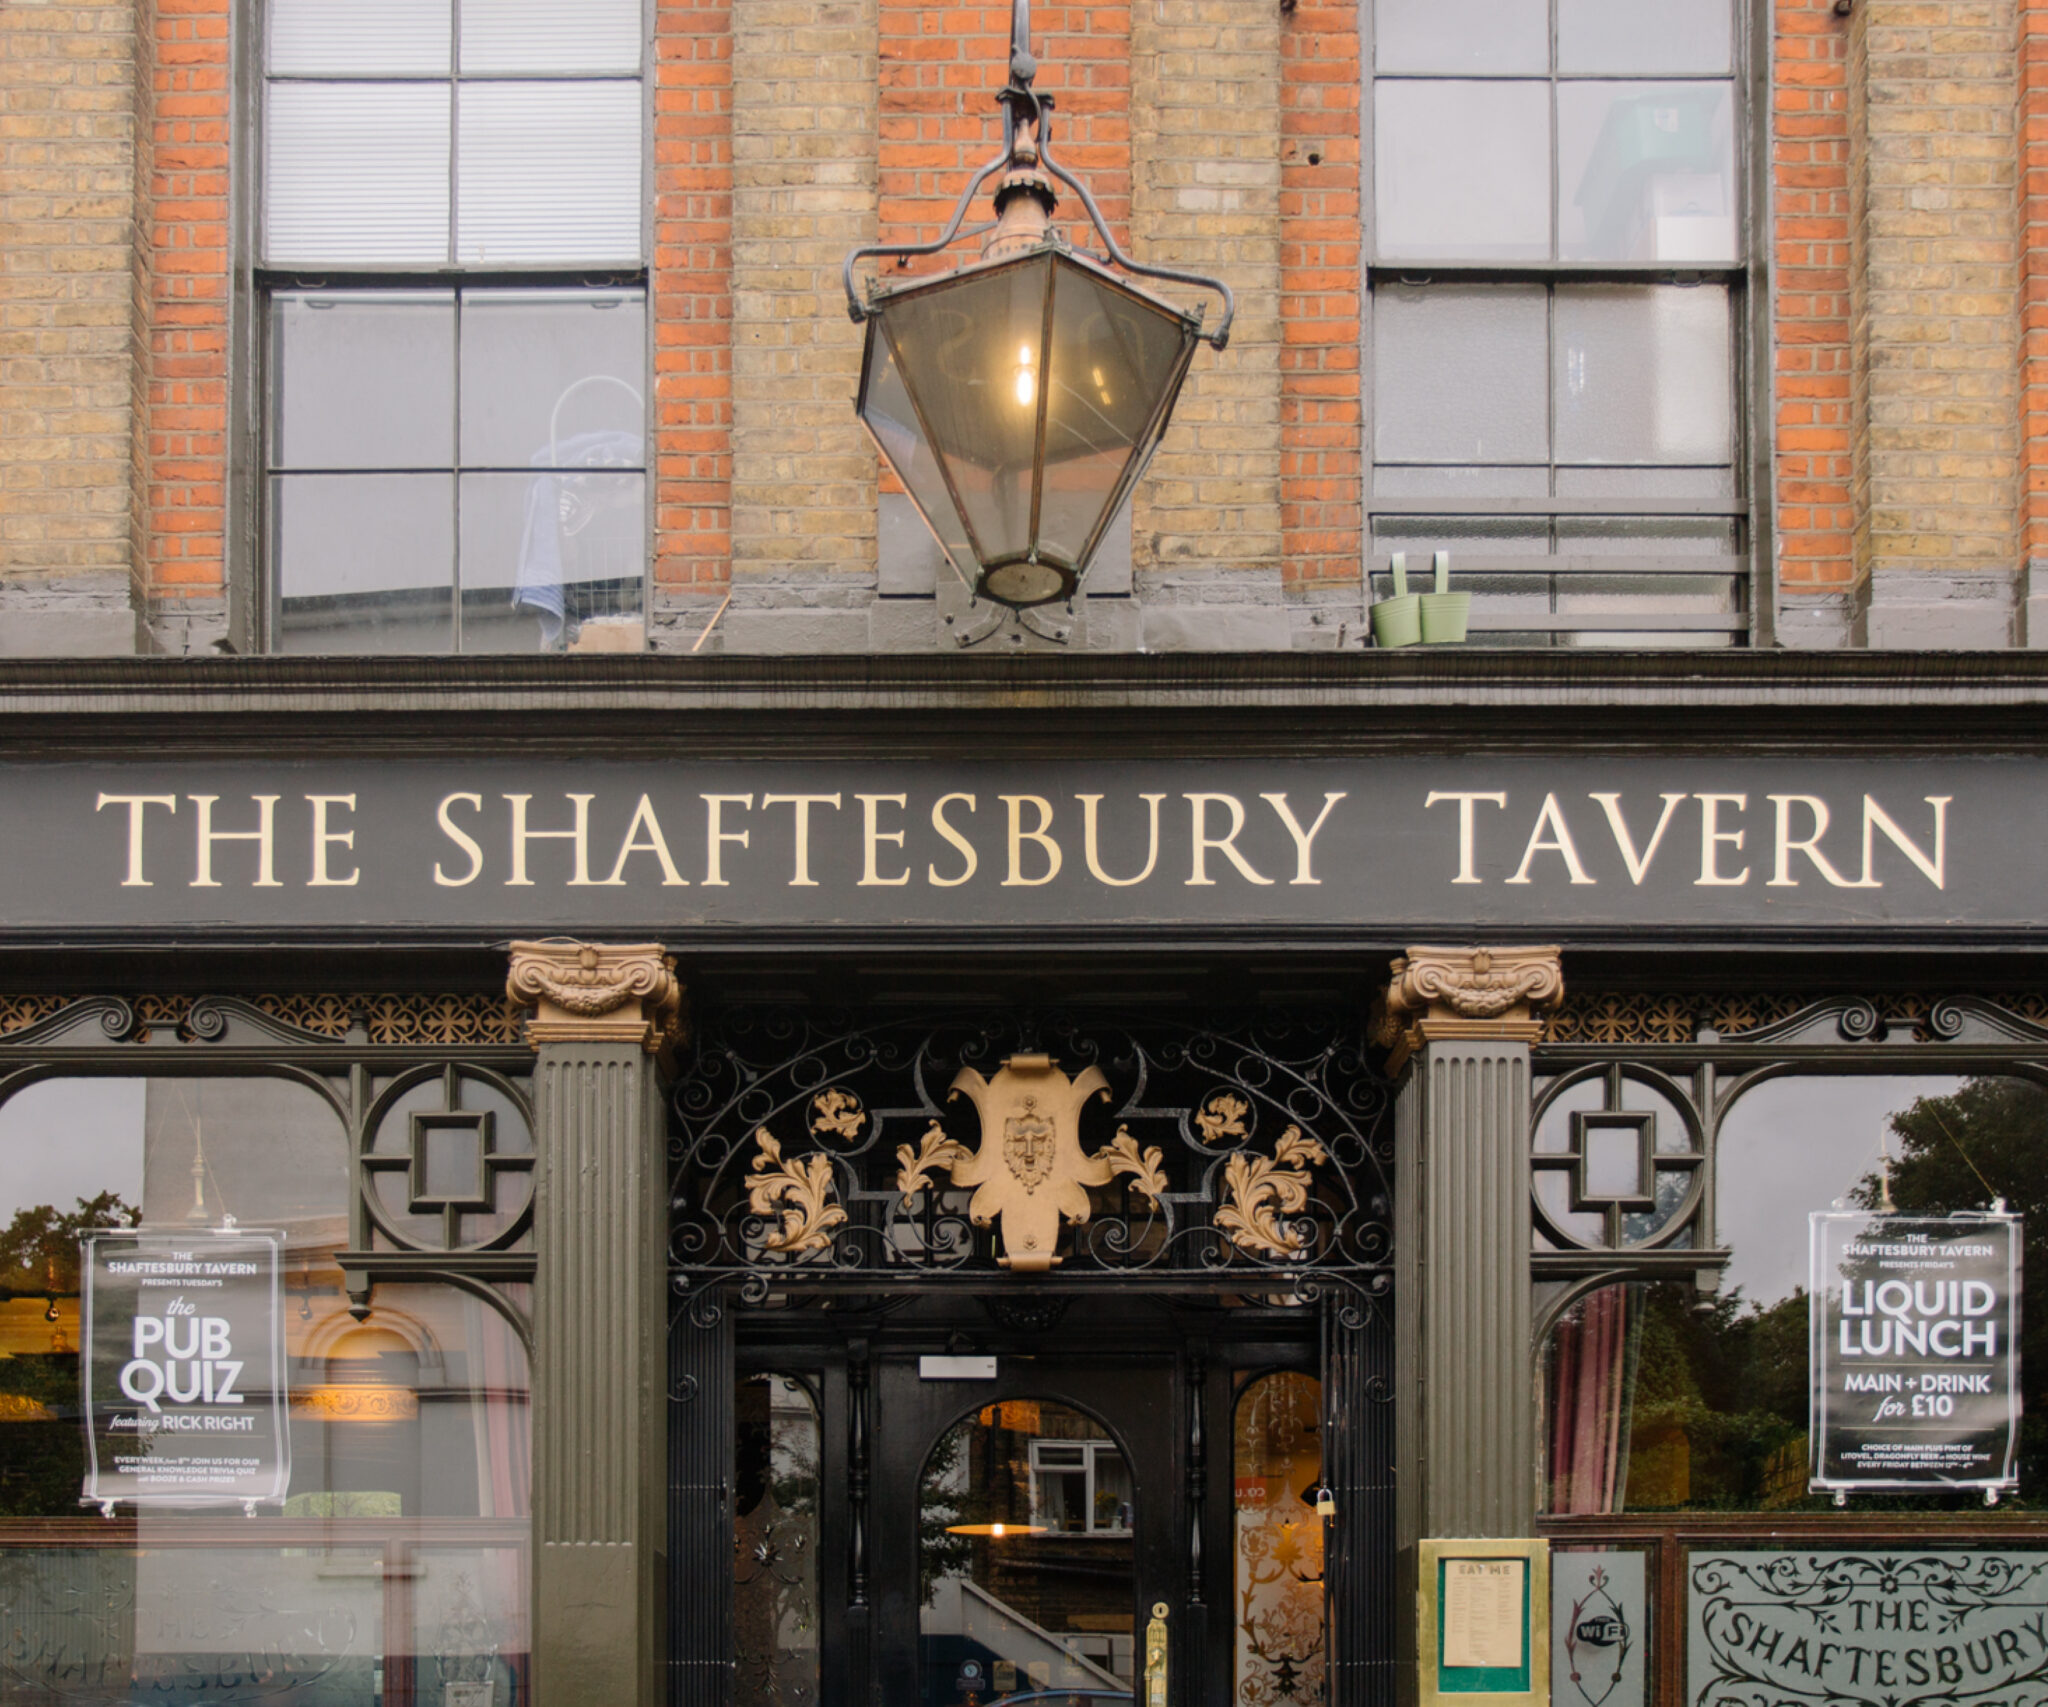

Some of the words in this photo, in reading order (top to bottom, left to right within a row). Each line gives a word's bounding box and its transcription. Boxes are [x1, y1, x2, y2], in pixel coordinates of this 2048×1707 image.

[96, 792, 360, 887] THE
[433, 791, 1347, 888] SHAFTESBURY
[1424, 791, 1952, 890] TAVERN
[1906, 1233, 1928, 1243] THE
[173, 1251, 193, 1261] THE
[1841, 1244, 1938, 1256] SHAFTESBURY
[1939, 1245, 1993, 1257] TAVERN
[108, 1261, 201, 1274] SHAFTESBURY
[204, 1263, 257, 1275] TAVERN
[1879, 1260, 1918, 1268] PRESENTS
[142, 1278, 181, 1286] PRESENTS
[182, 1279, 223, 1287] TUESDAY'S
[166, 1295, 196, 1316] the
[1841, 1279, 1996, 1325] LIQUID
[133, 1316, 232, 1360] PUB
[1839, 1319, 1996, 1357] LUNCH
[120, 1359, 245, 1413] QUIZ
[1844, 1373, 1901, 1392] MAIN
[1920, 1373, 1991, 1393] DRINK
[1872, 1395, 1906, 1423] for
[1911, 1394, 1954, 1418] £10
[109, 1414, 160, 1431] featuring
[162, 1415, 202, 1430] RICK
[204, 1416, 254, 1431] RIGHT
[1861, 1443, 1891, 1451] CHOICE
[1961, 1444, 1974, 1452] OF
[114, 1456, 139, 1464] EVERY
[191, 1457, 210, 1465] JOIN
[241, 1458, 260, 1466] OUR
[1873, 1452, 1920, 1460] DRAGONFLY
[119, 1466, 156, 1474] GENERAL
[157, 1466, 208, 1474] KNOWLEDGE
[236, 1467, 257, 1476] QUIZ
[1882, 1461, 1910, 1469] FRIDAY
[1910, 1461, 1944, 1469] BETWEEN
[150, 1475, 177, 1483] BOOZE
[208, 1476, 236, 1484] PRIZES
[1489, 1564, 1511, 1575] ME
[1848, 1599, 1930, 1633] THE
[1720, 1611, 2048, 1688] SHAFTESBURY
